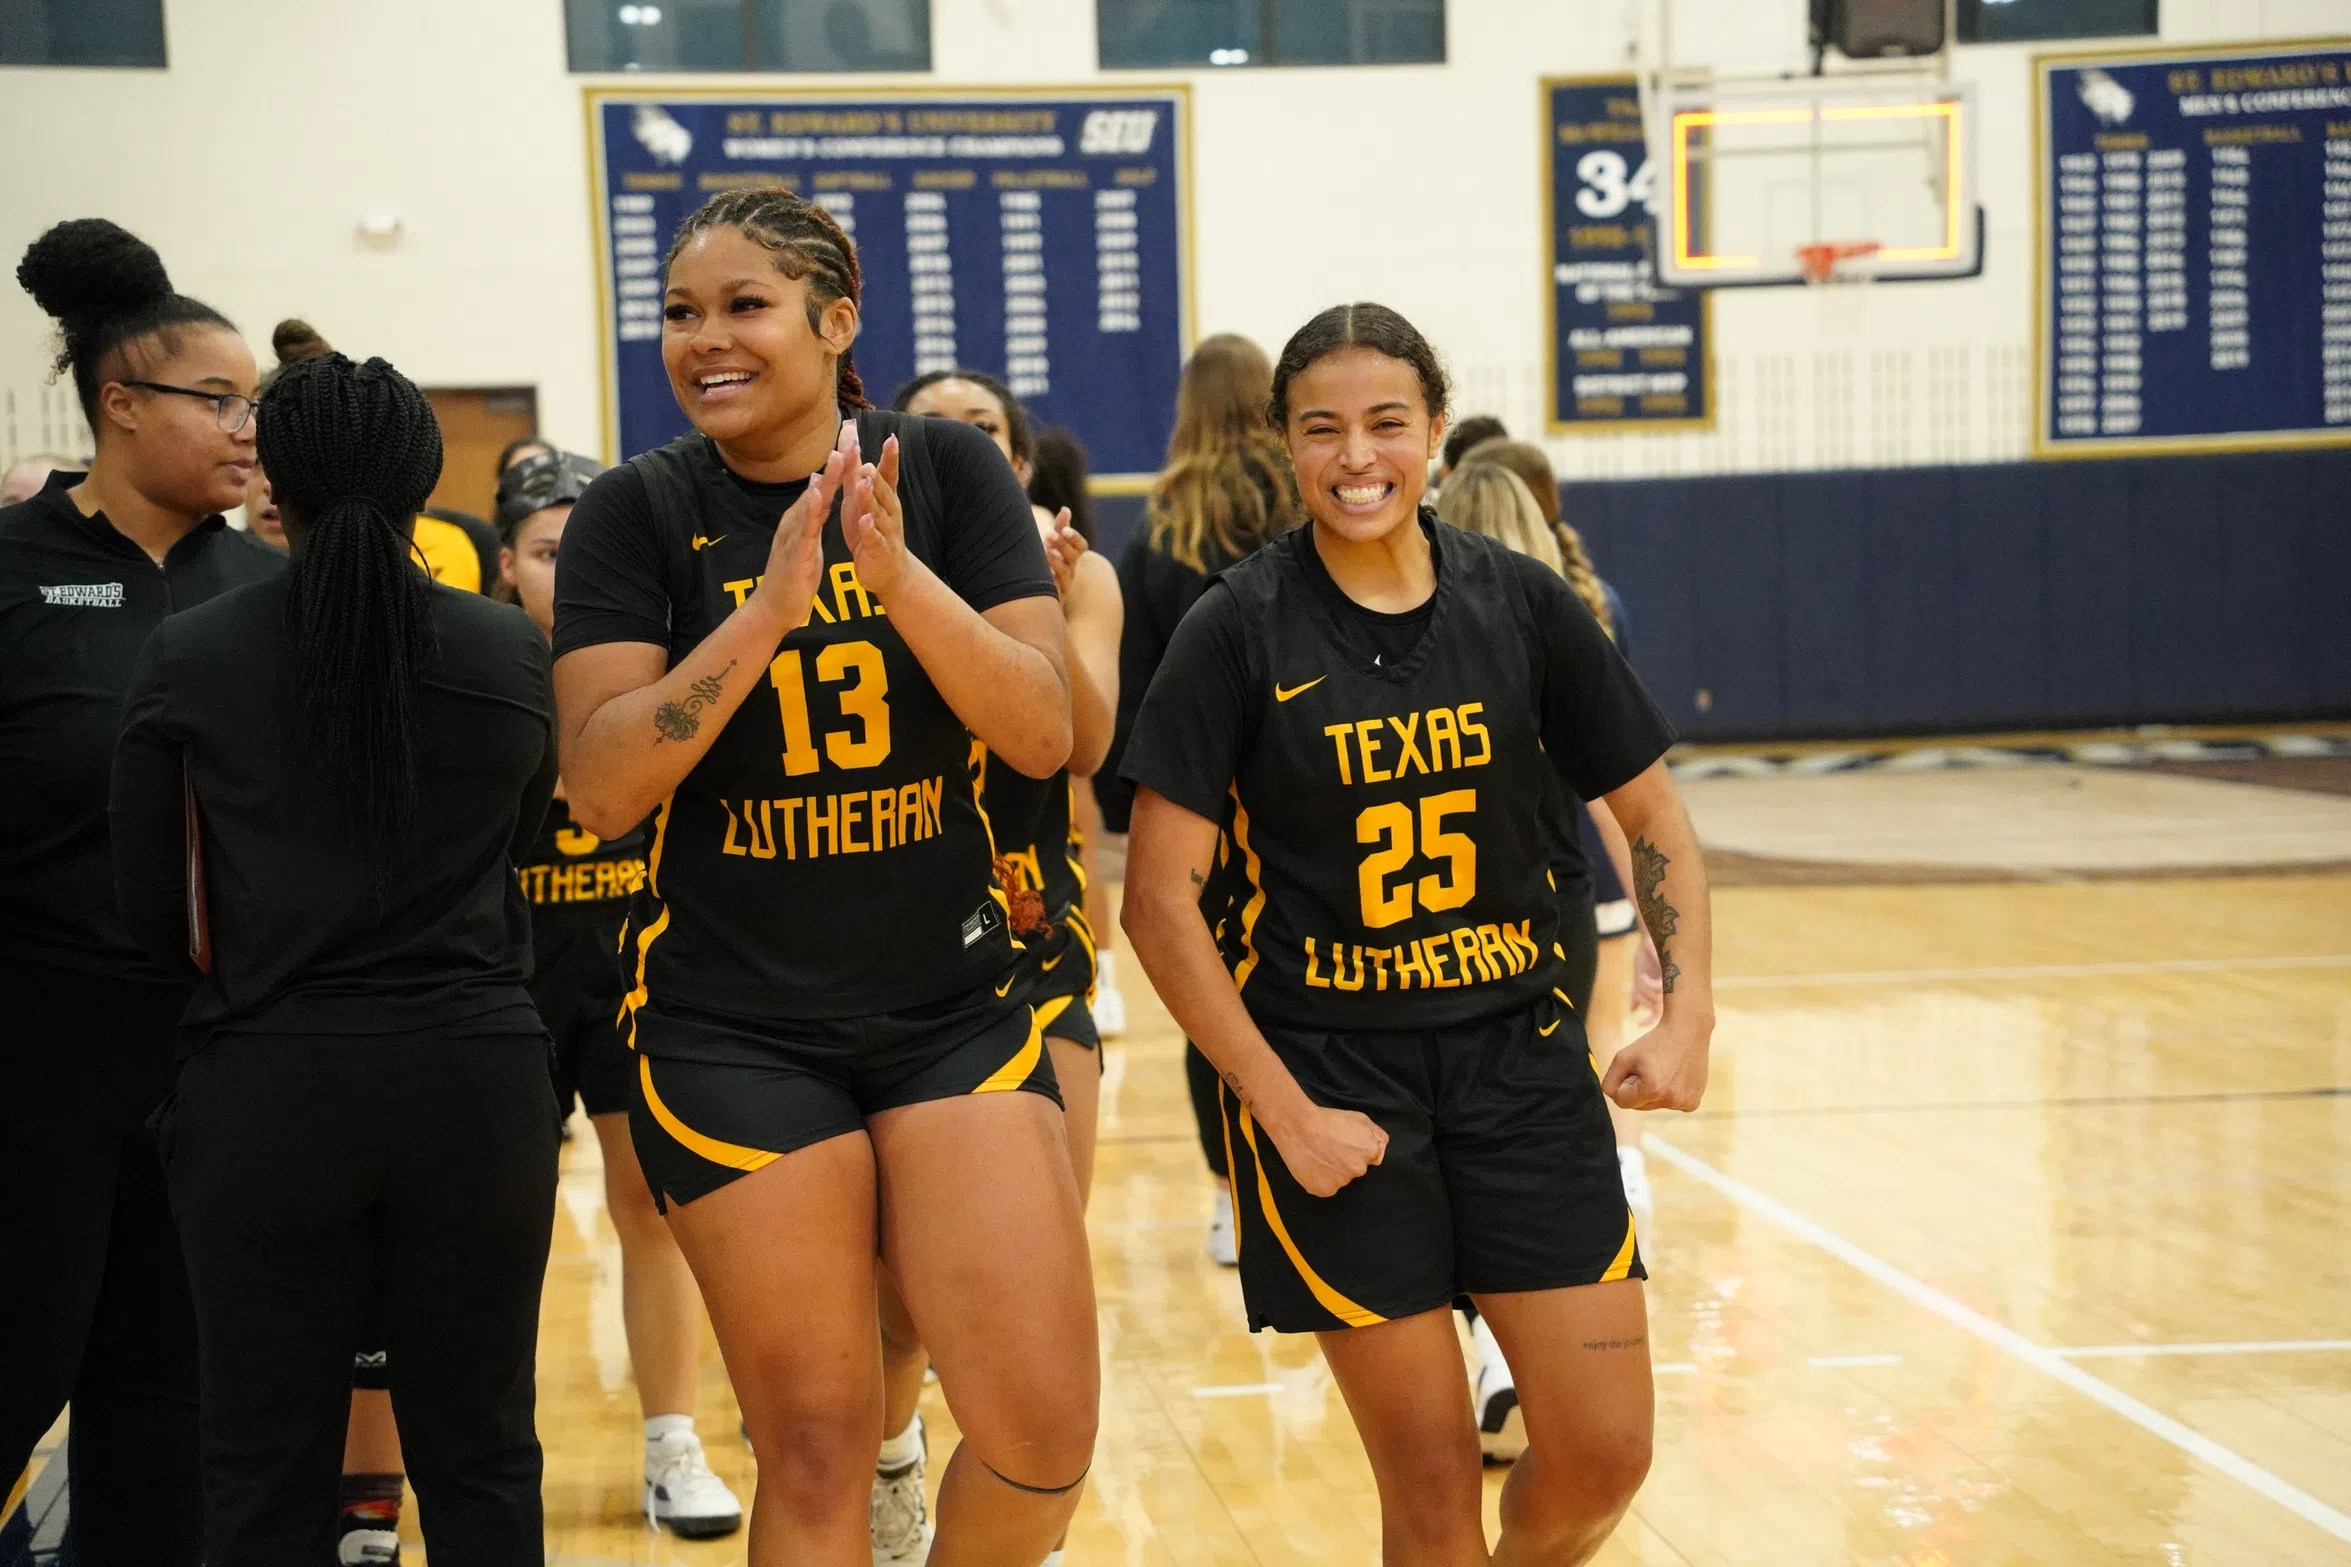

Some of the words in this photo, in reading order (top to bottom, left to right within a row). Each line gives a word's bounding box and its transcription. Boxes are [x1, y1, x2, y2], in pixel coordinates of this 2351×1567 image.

[1080, 111, 1158, 153] SEU
[45, 596, 122, 607] BASKETBALL
[60, 583, 122, 598] EDWARD'S
[770, 641, 891, 777] 13
[1324, 702, 1492, 785] TEXAS
[720, 775, 943, 860] LUTHERAN
[1356, 789, 1477, 929] 25
[983, 914, 991, 925] L
[1304, 919, 1539, 991] LUTHERAN
